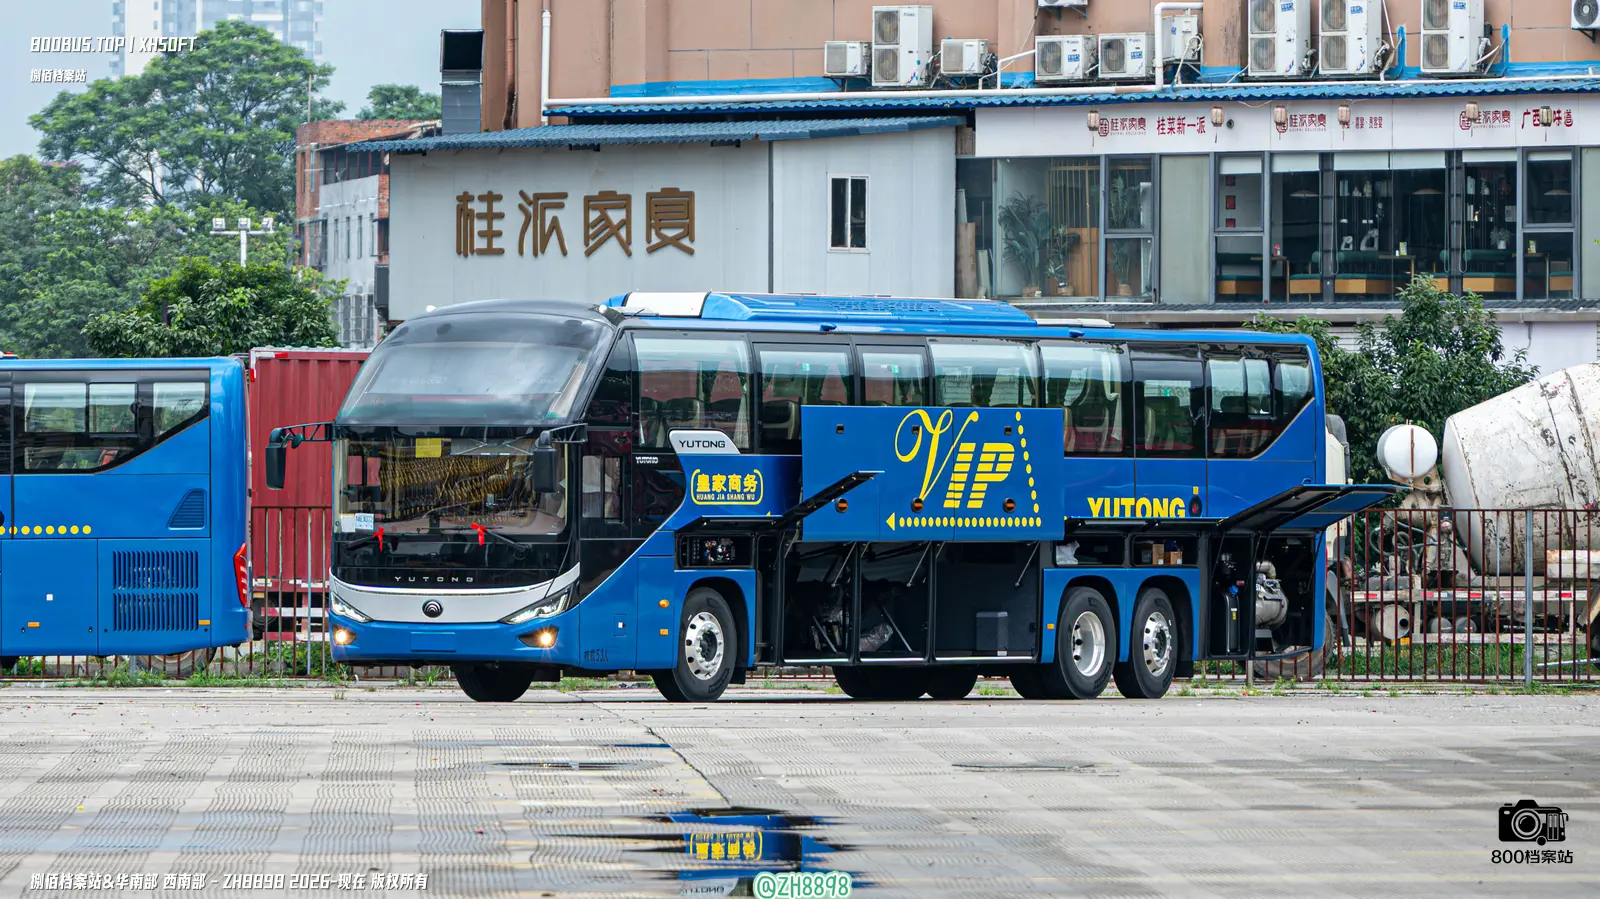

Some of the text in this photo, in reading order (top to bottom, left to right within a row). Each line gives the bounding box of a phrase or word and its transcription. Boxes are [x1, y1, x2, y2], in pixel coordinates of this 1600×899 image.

[1156, 115, 1206, 136] 桂菜新一派
[1521, 108, 1574, 129] 广西味道
[456, 187, 695, 257] 桂派家宴
[679, 440, 726, 449] YUTONG
[895, 409, 1015, 509] VIP
[696, 473, 758, 493] 皇家商务
[696, 493, 755, 501] HUANG JIA SHANG WU
[1087, 496, 1186, 518] YUTONG
